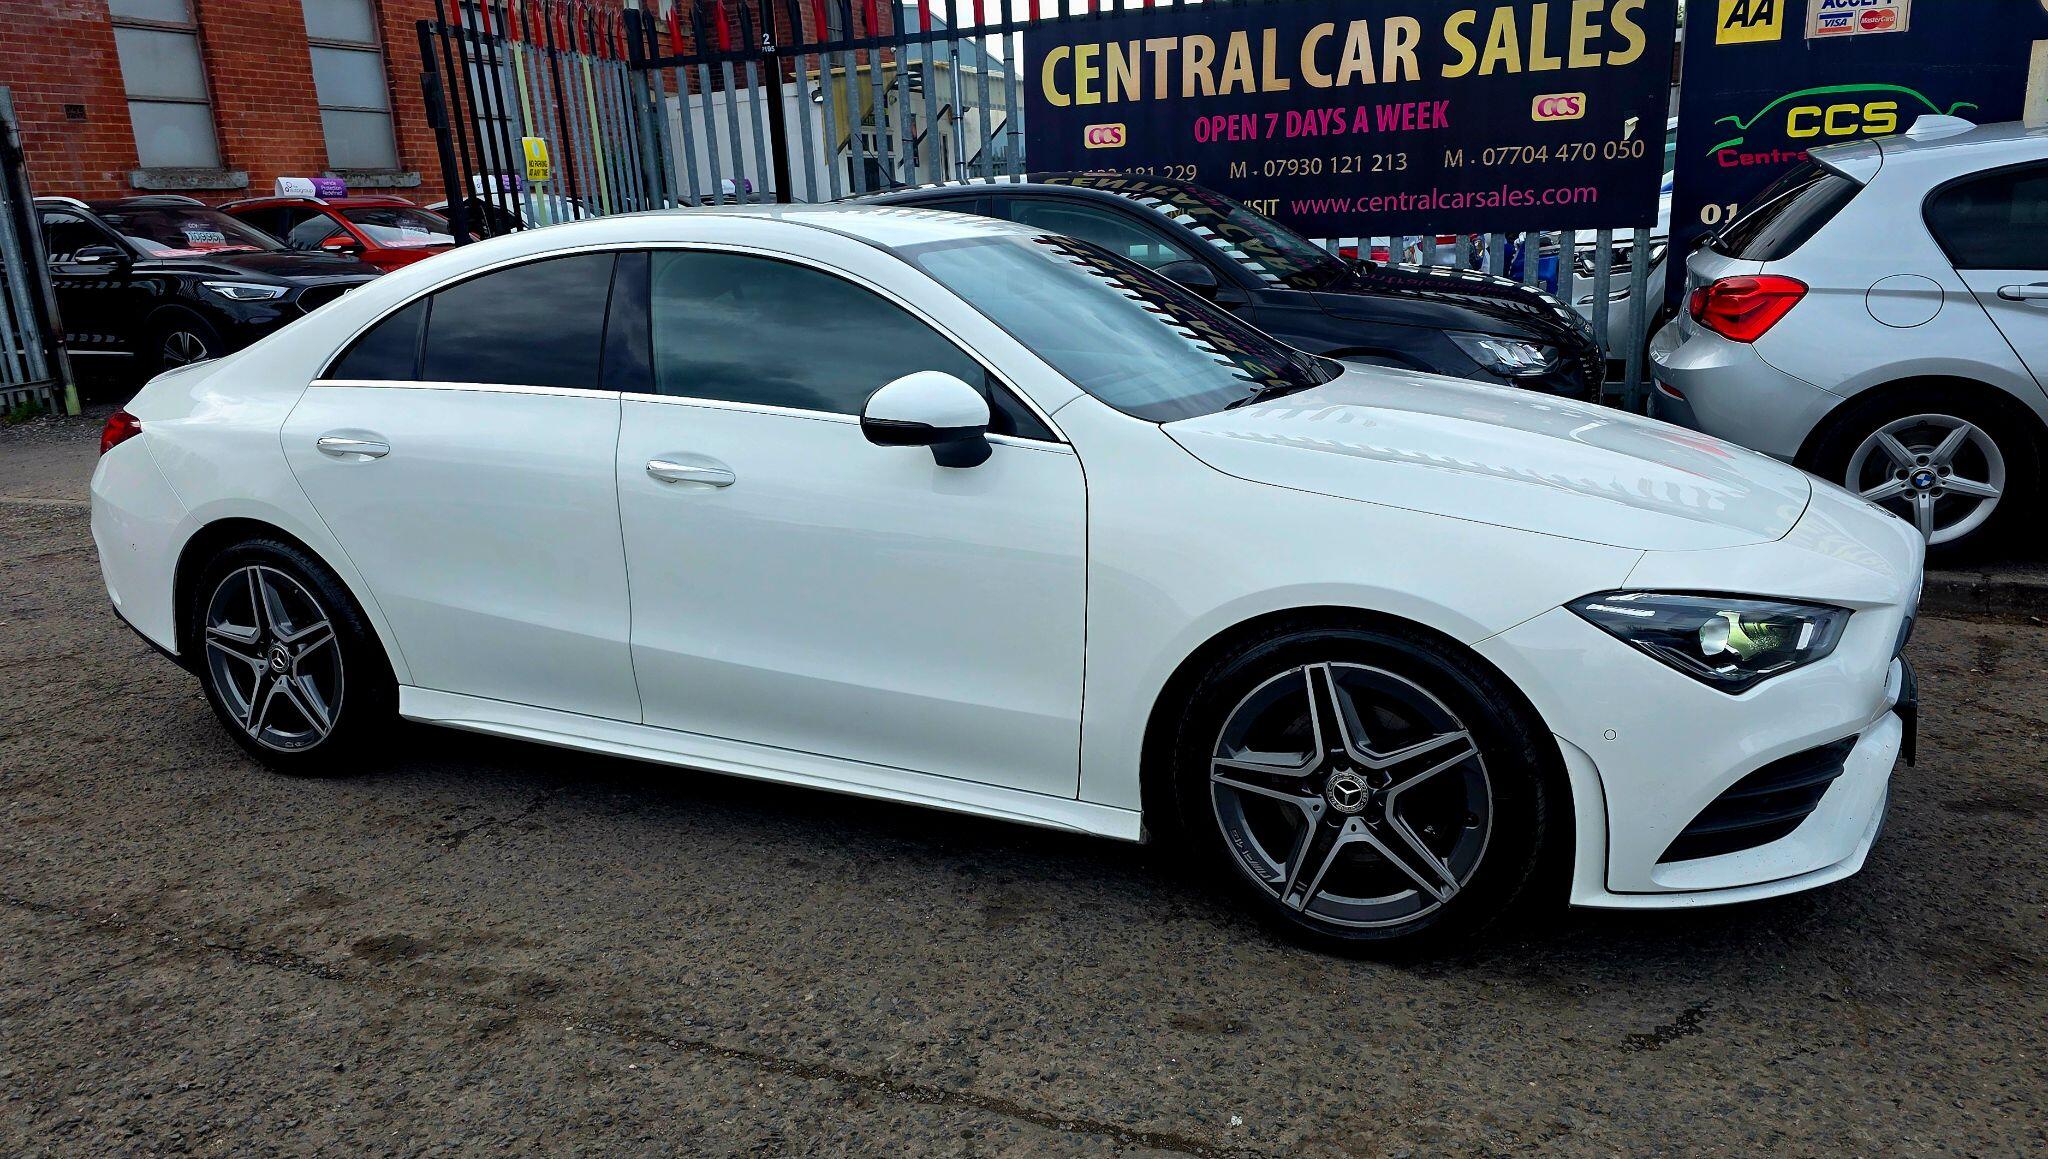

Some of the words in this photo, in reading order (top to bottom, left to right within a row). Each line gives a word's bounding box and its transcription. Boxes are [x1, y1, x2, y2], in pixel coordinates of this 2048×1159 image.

[1723, 0, 1773, 28] AA
[1824, 18, 1848, 28] VISA
[1860, 15, 1896, 24] MasterCard
[762, 32, 771, 45] 2
[1041, 28, 1291, 107] CENTRAL
[1300, 15, 1421, 89] CAR
[1441, 0, 1646, 78] SALES
[1537, 96, 1580, 118] CCS
[1786, 101, 1898, 138] CCS
[1194, 113, 1257, 143] OPEN
[1264, 113, 1279, 139] 7
[1285, 107, 1347, 138] DAYS
[1352, 105, 1369, 134] A
[1375, 100, 1450, 132] WEEK
[1088, 127, 1122, 146] CCS
[1263, 157, 1323, 177] 07930
[1330, 155, 1363, 174] 121
[1371, 152, 1408, 172] 213
[1482, 145, 1549, 166] 07704
[1554, 142, 1597, 162] 470
[1603, 139, 1645, 160] 050
[1163, 164, 1197, 181] 229
[1291, 184, 1598, 216] www.centralcarsales.com
